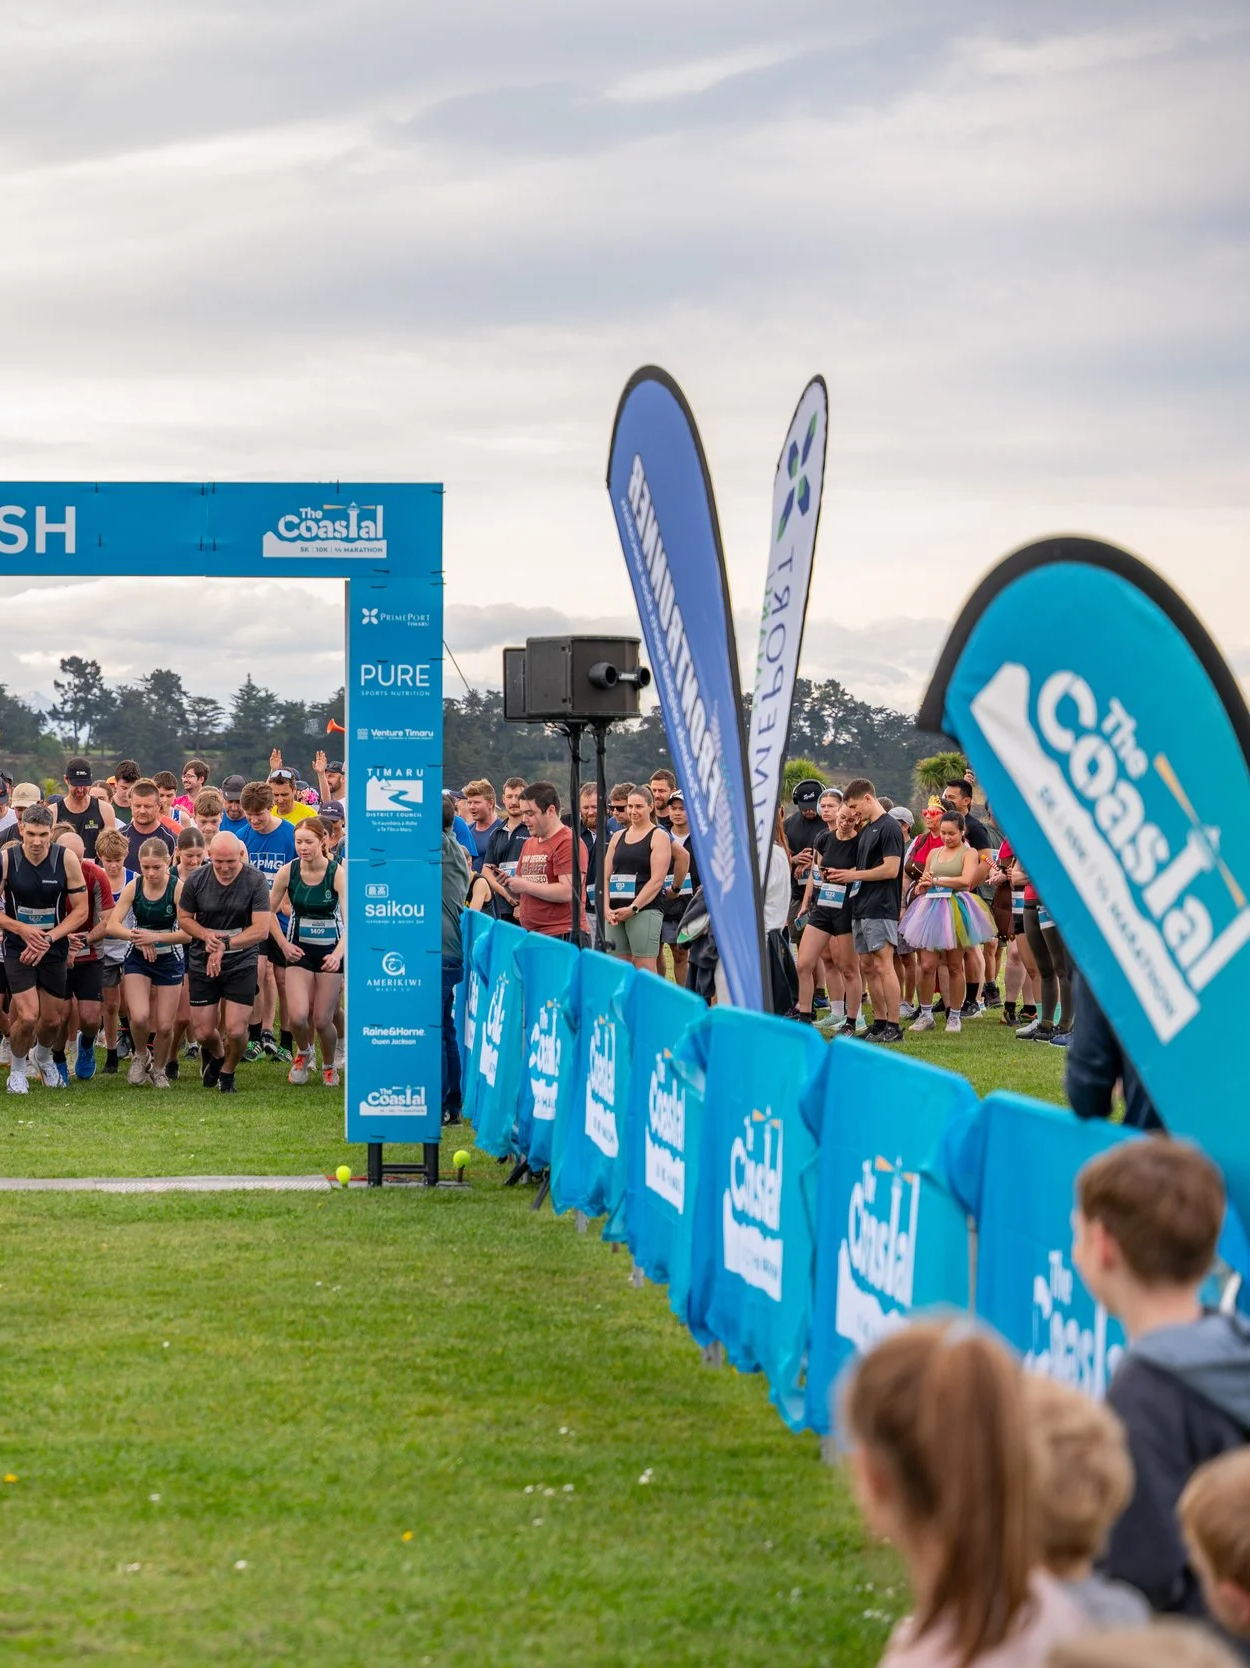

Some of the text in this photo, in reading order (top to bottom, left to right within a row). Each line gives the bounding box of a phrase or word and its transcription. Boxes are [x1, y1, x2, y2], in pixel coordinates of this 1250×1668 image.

[299, 507, 323, 519] The
[360, 664, 430, 687] PURE
[371, 728, 434, 737] Venture Timaru
[1101, 697, 1149, 779] The
[366, 768, 424, 777] TIMARU
[250, 859, 285, 870] KPMG
[365, 900, 425, 917] saikou
[366, 979, 422, 987] AMERIKIWI
[379, 1087, 393, 1095] The
